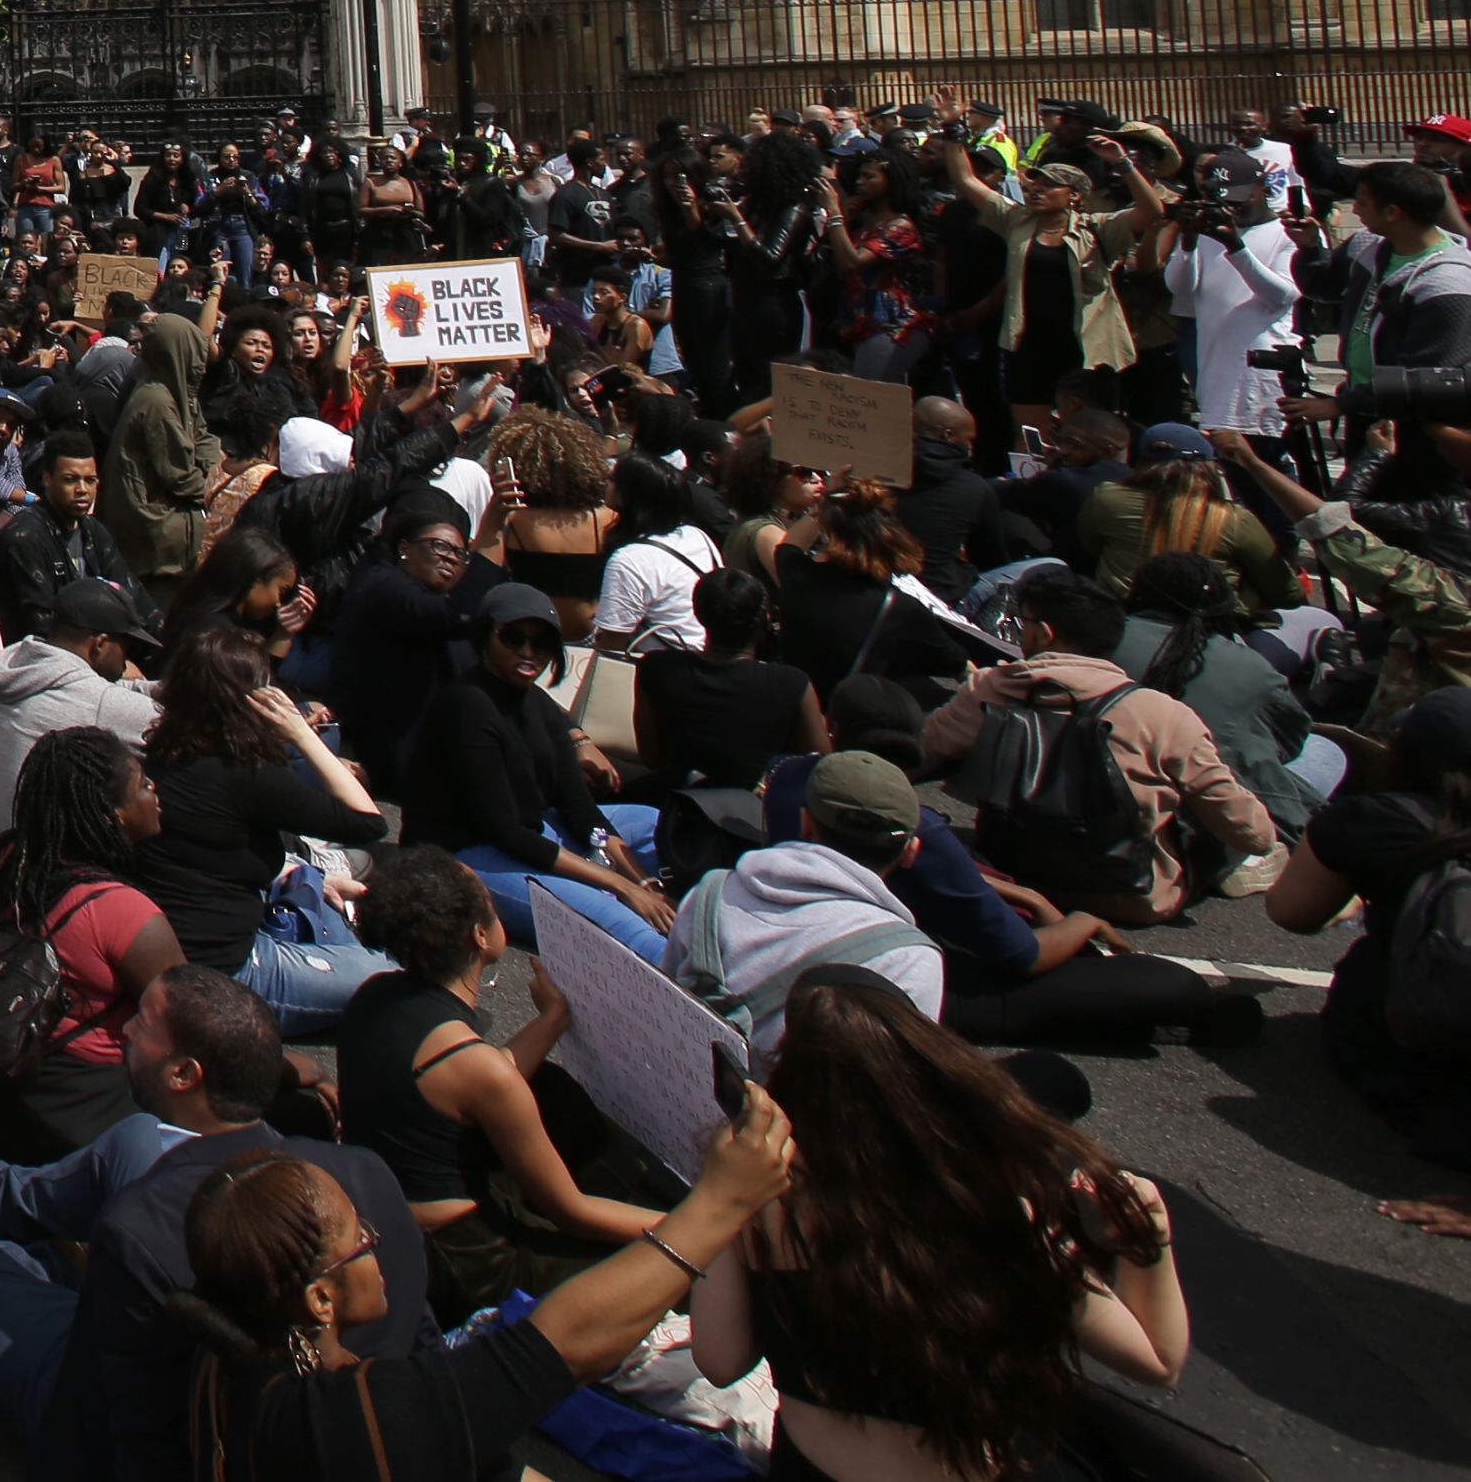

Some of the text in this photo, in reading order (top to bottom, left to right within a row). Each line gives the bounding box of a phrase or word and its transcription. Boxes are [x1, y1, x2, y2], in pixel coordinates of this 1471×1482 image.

[85, 263, 147, 288] BLACK
[432, 277, 501, 300] BLACK
[435, 301, 504, 323] LIVES
[438, 323, 521, 346] MATTER
[787, 373, 814, 387] THE
